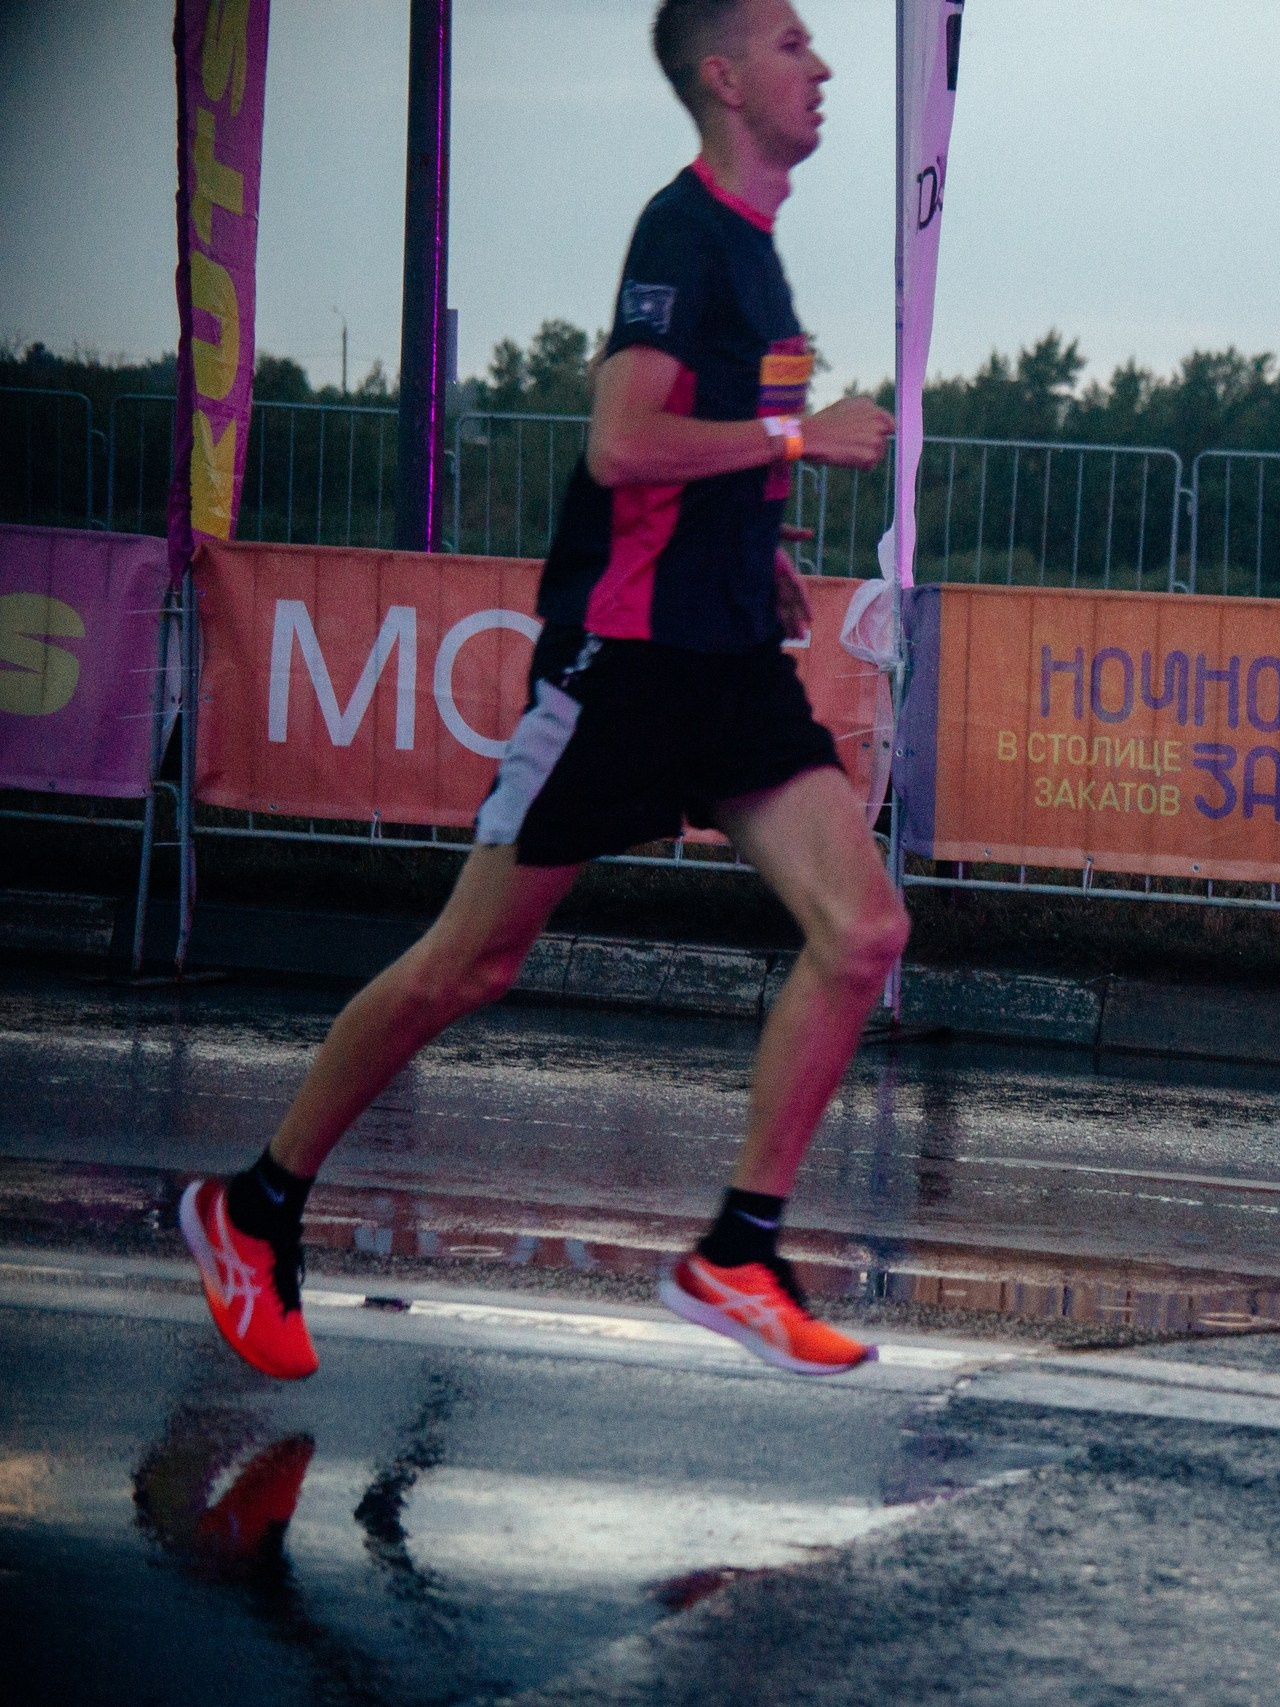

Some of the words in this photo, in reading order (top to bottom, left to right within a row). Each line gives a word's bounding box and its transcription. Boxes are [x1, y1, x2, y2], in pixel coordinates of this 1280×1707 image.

[997, 730, 1019, 762] В
[1027, 732, 1183, 778] СТОЛИЦЕ
[1033, 776, 1182, 817] ЗАКАТОВ
